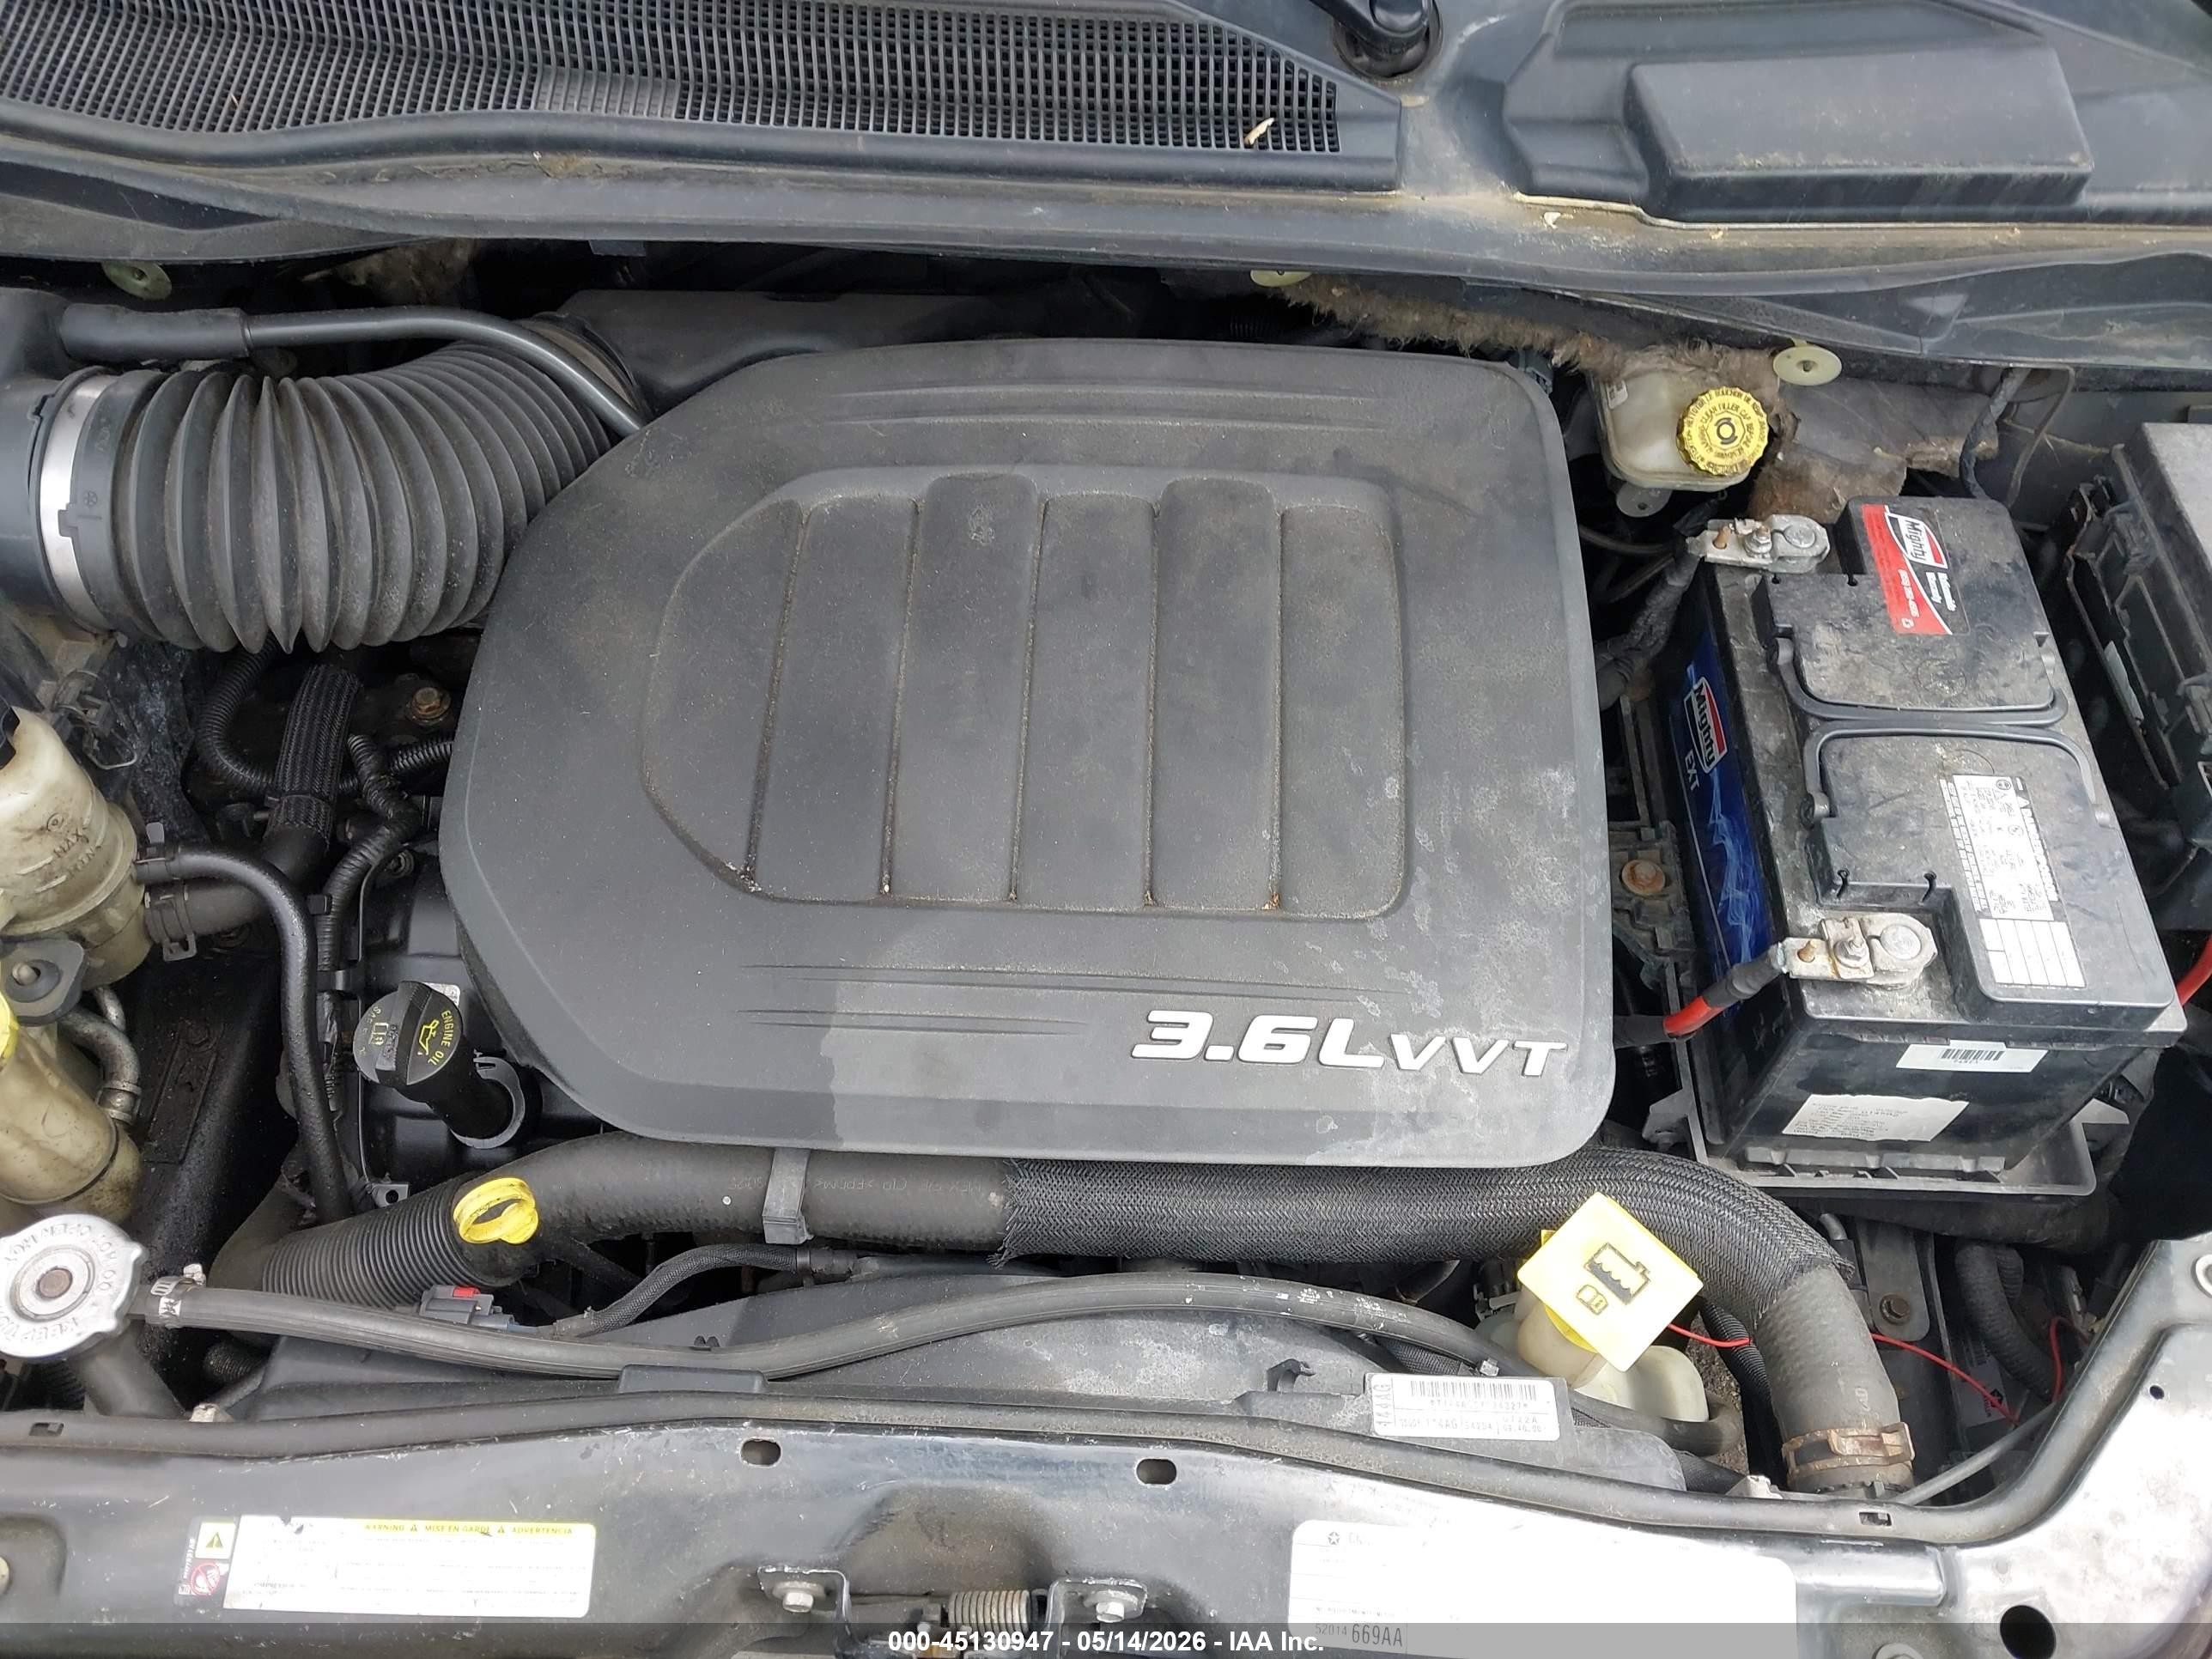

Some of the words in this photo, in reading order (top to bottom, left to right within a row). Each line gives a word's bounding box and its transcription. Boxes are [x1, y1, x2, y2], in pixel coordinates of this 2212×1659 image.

[1700, 405, 1717, 424] CLEAN
[1718, 402, 1740, 411] FILLER
[1905, 517, 1926, 561] Mighty
[1692, 683, 1717, 765] Mighty
[1683, 749, 1700, 791] EXT
[52, 827, 83, 858] MAX
[441, 1009, 454, 1047] ENGINE
[1130, 1009, 1385, 1069] 3.6L
[1389, 1032, 1569, 1078] VVT
[428, 1050, 445, 1066] OIL
[1315, 1622, 1348, 1638] 52014
[1351, 1623, 1404, 1648] 669AA
